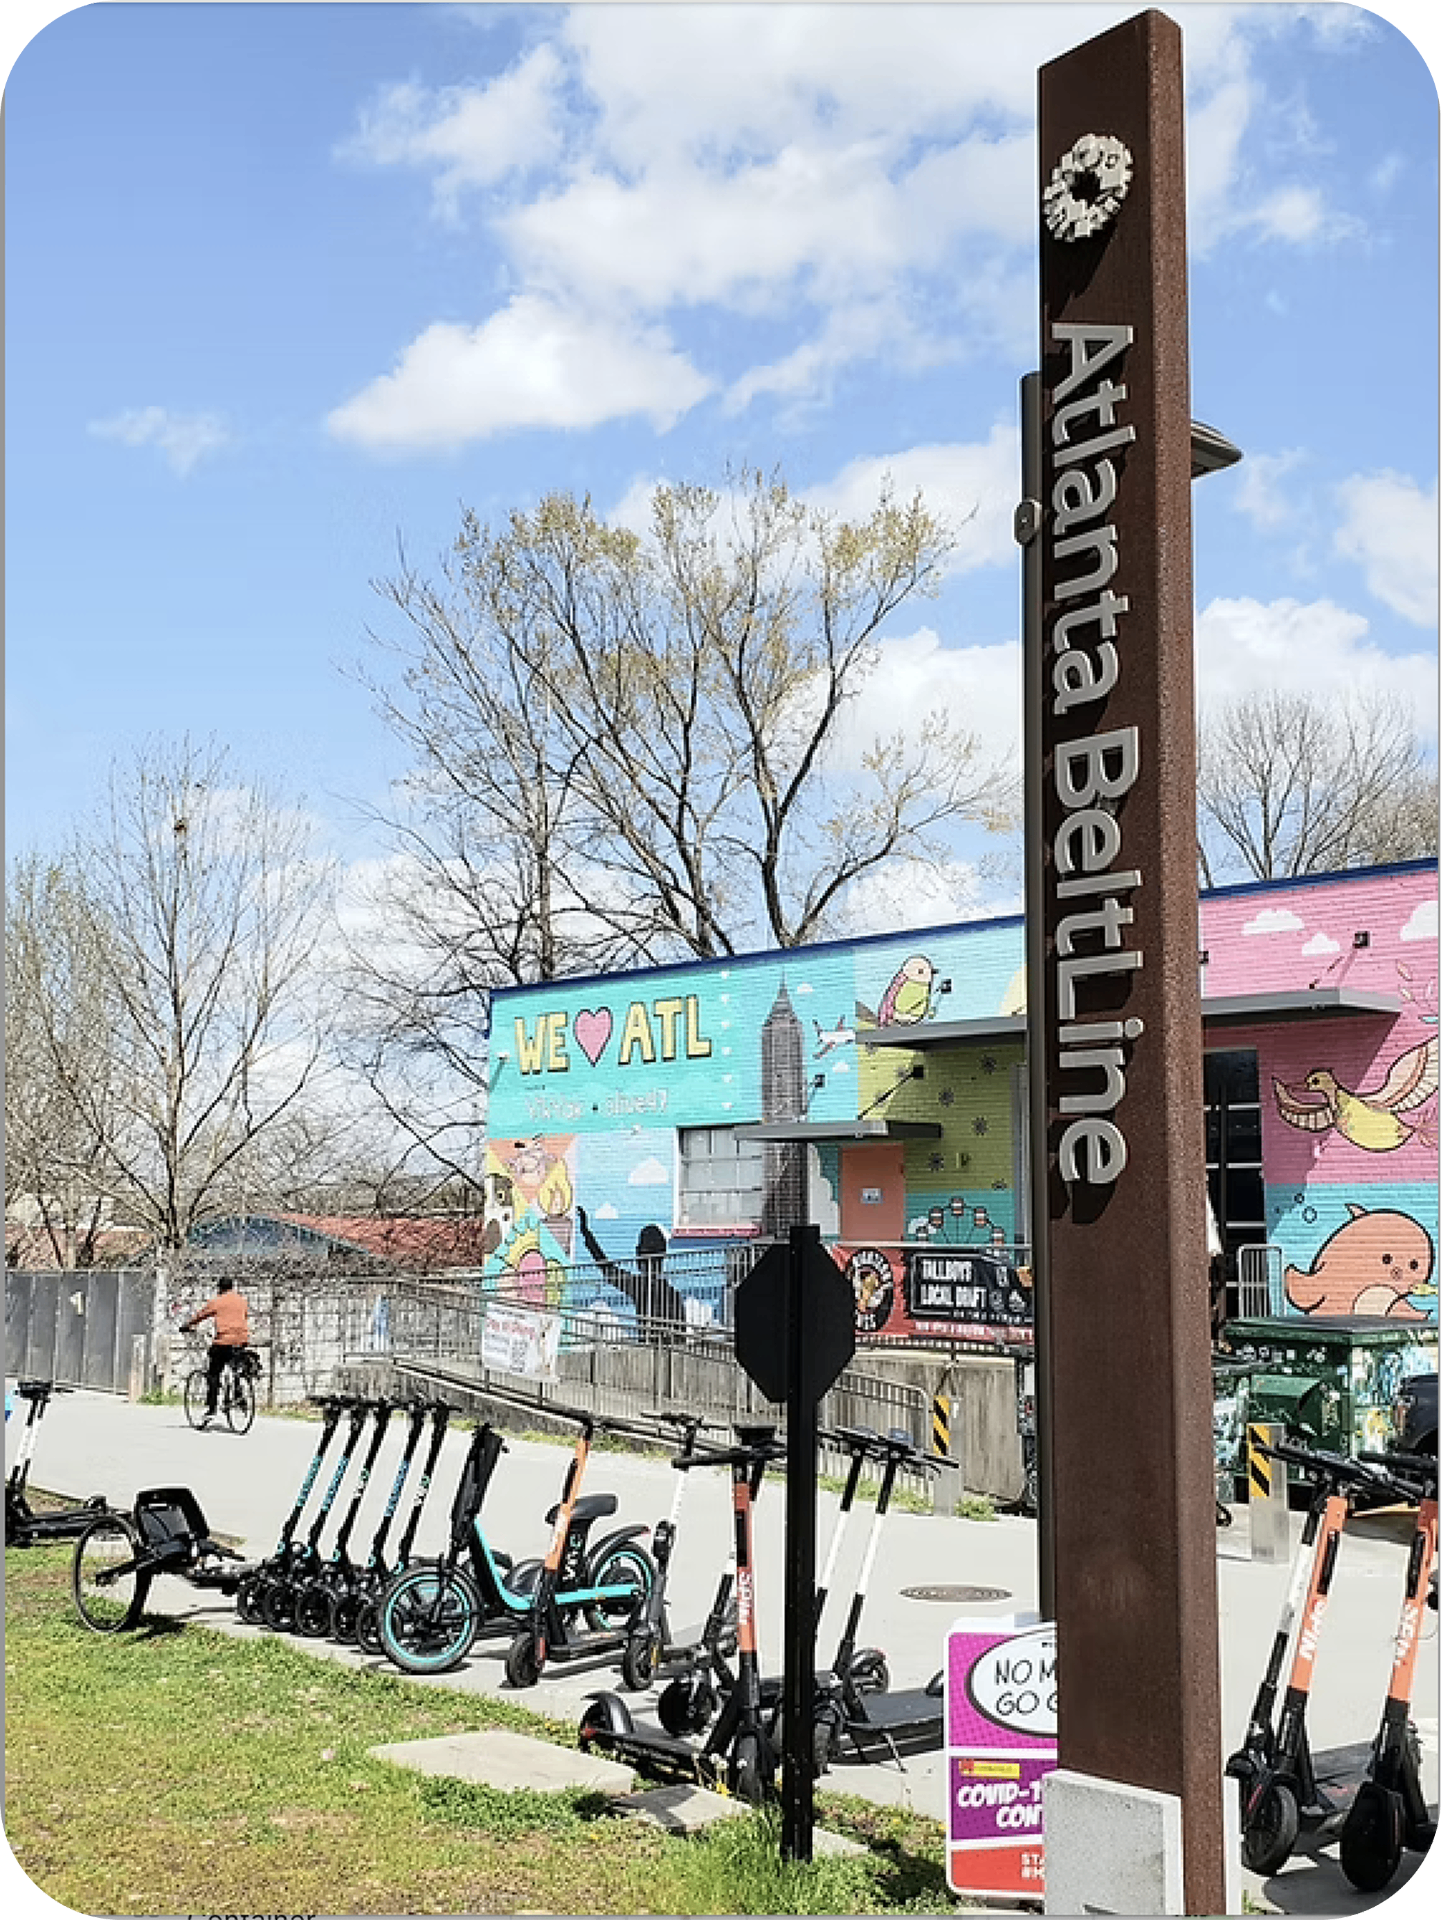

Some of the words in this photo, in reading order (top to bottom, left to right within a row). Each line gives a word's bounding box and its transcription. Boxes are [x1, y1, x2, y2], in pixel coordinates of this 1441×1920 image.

[1052, 323, 1136, 715] Atlanta
[1054, 726, 1144, 1185] BeltLine
[514, 1011, 570, 1075] WE
[618, 994, 712, 1066] ATL
[995, 1658, 1033, 1686] NO
[996, 1690, 1040, 1716] GO
[957, 1780, 1041, 1808] COVID-1
[996, 1803, 1043, 1828] CON
